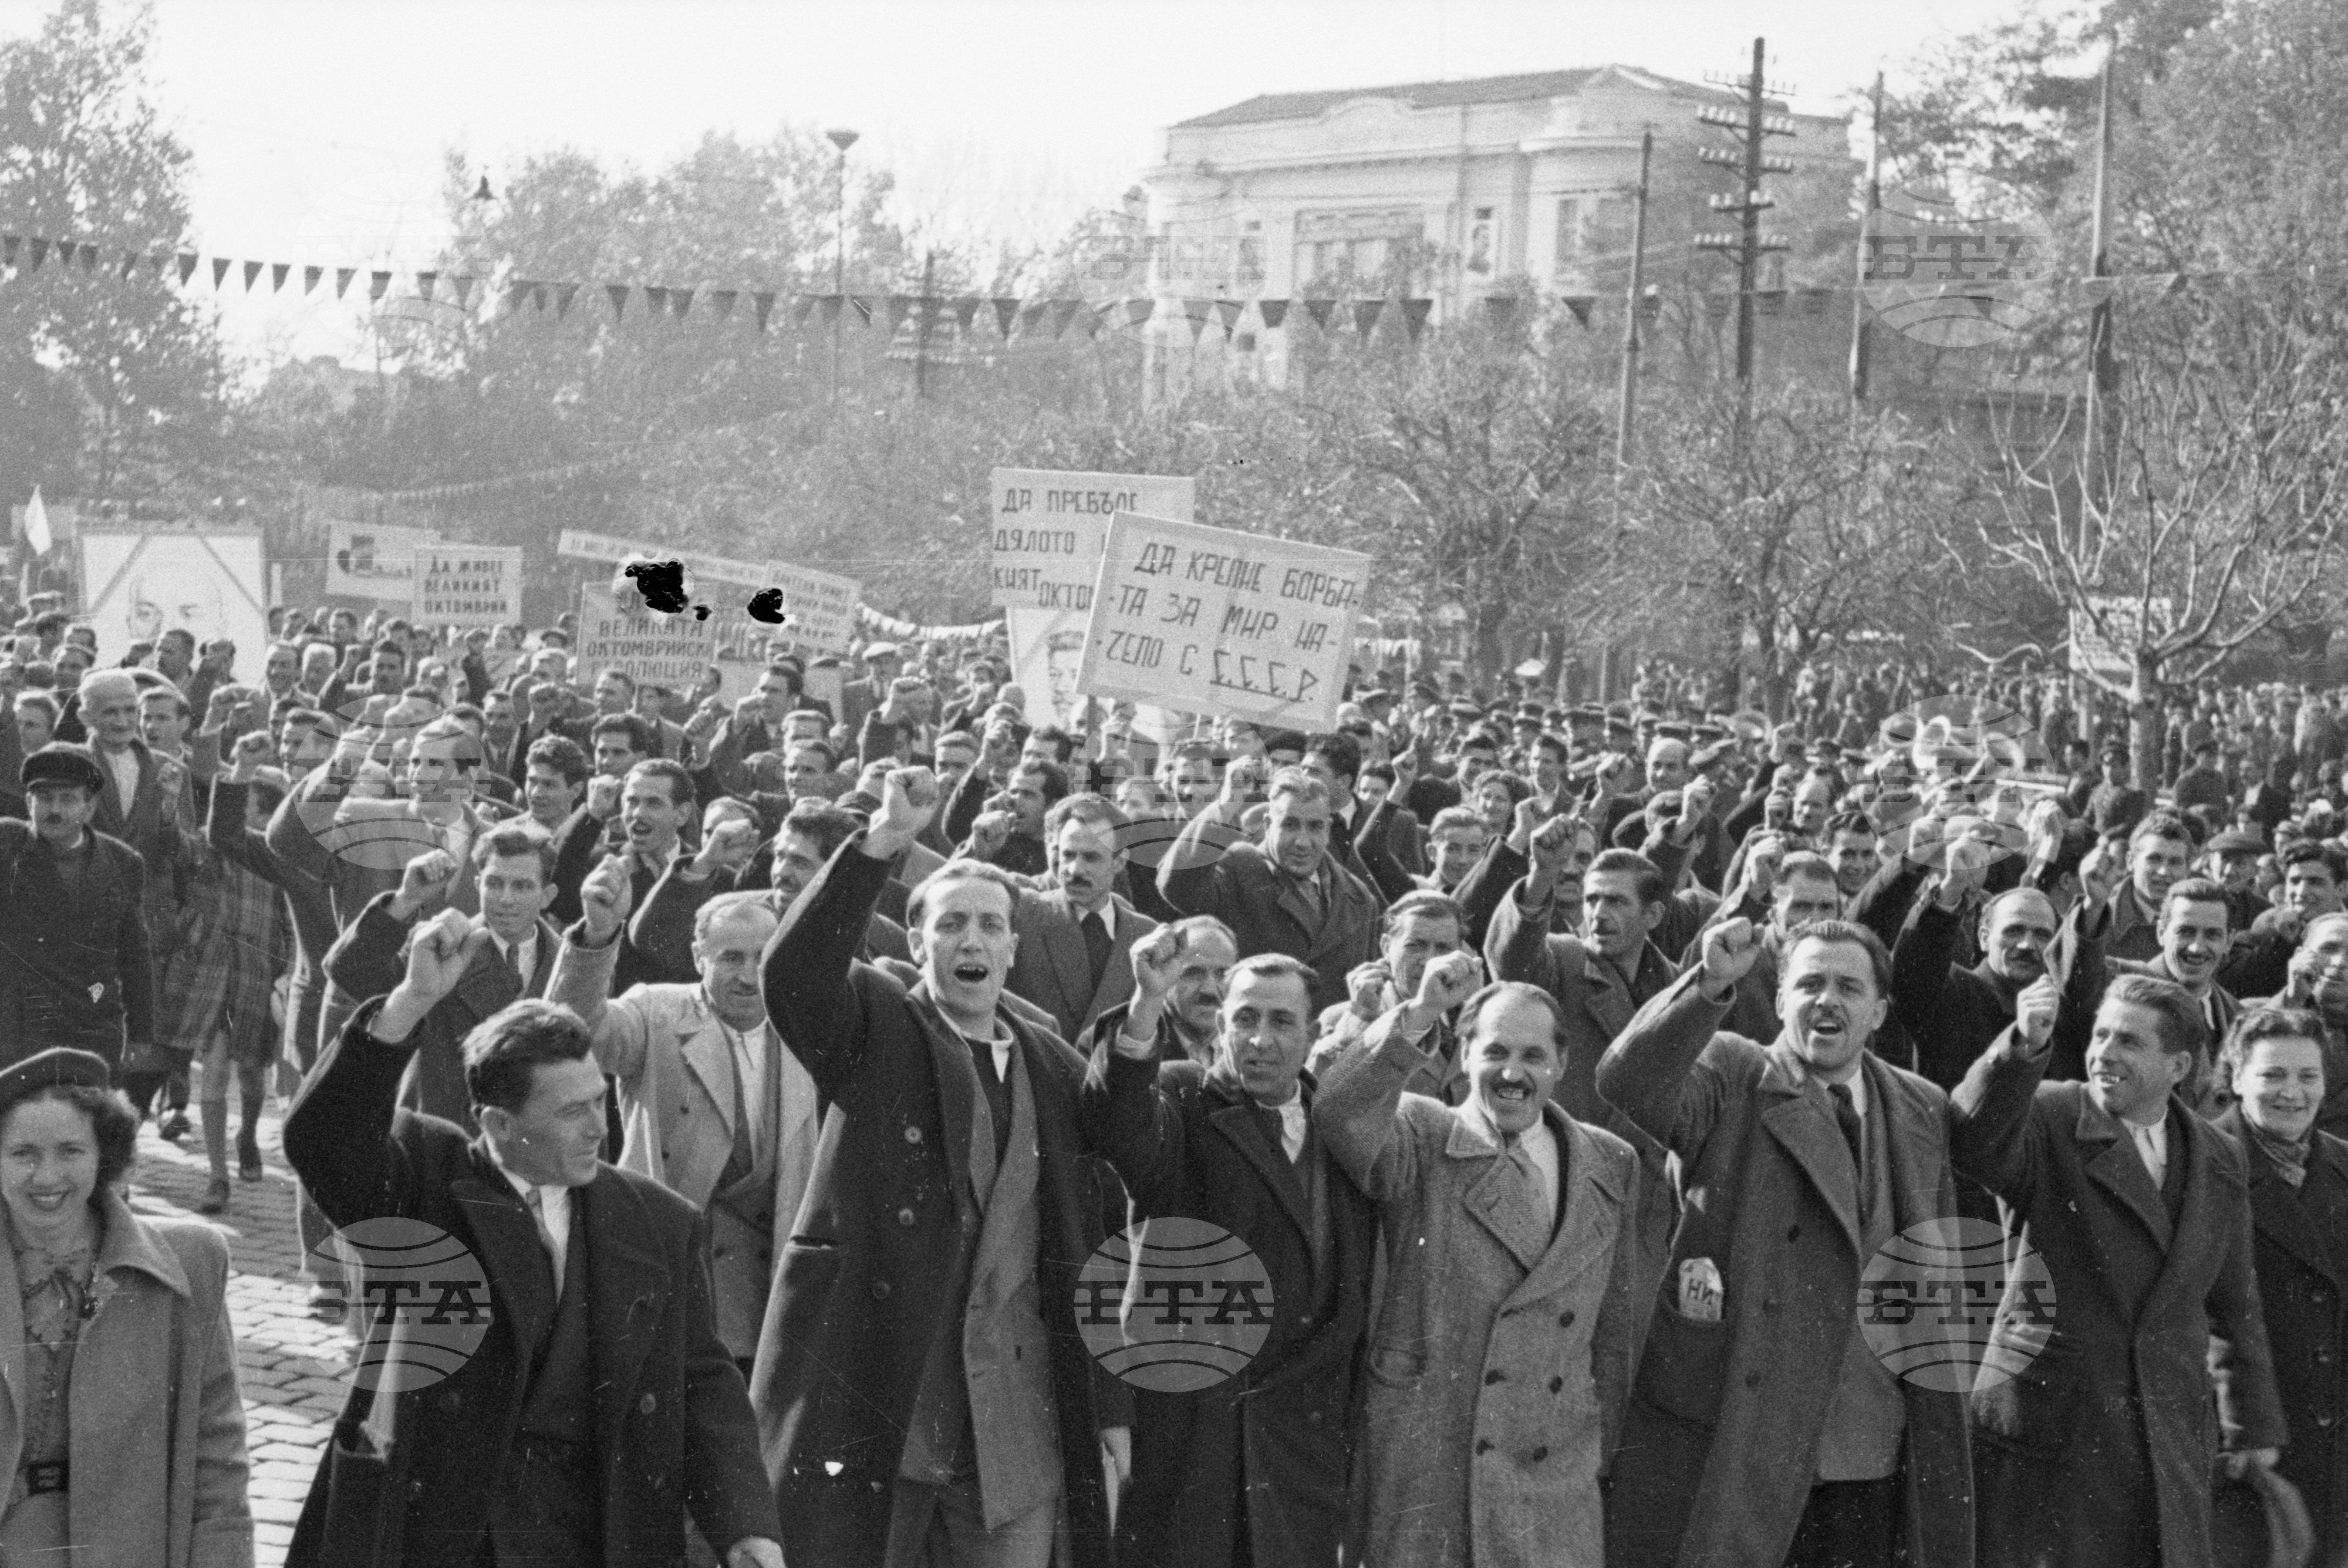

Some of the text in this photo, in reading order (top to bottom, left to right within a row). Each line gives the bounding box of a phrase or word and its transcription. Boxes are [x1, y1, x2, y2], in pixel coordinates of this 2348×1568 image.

[1001, 487, 1032, 513] ДА
[994, 528, 1075, 554] ДЯЛОТО
[1133, 542, 1177, 575] ДА
[1159, 592, 1201, 627] ЗА
[1220, 605, 1279, 639] МИР
[1180, 644, 1198, 675] С
